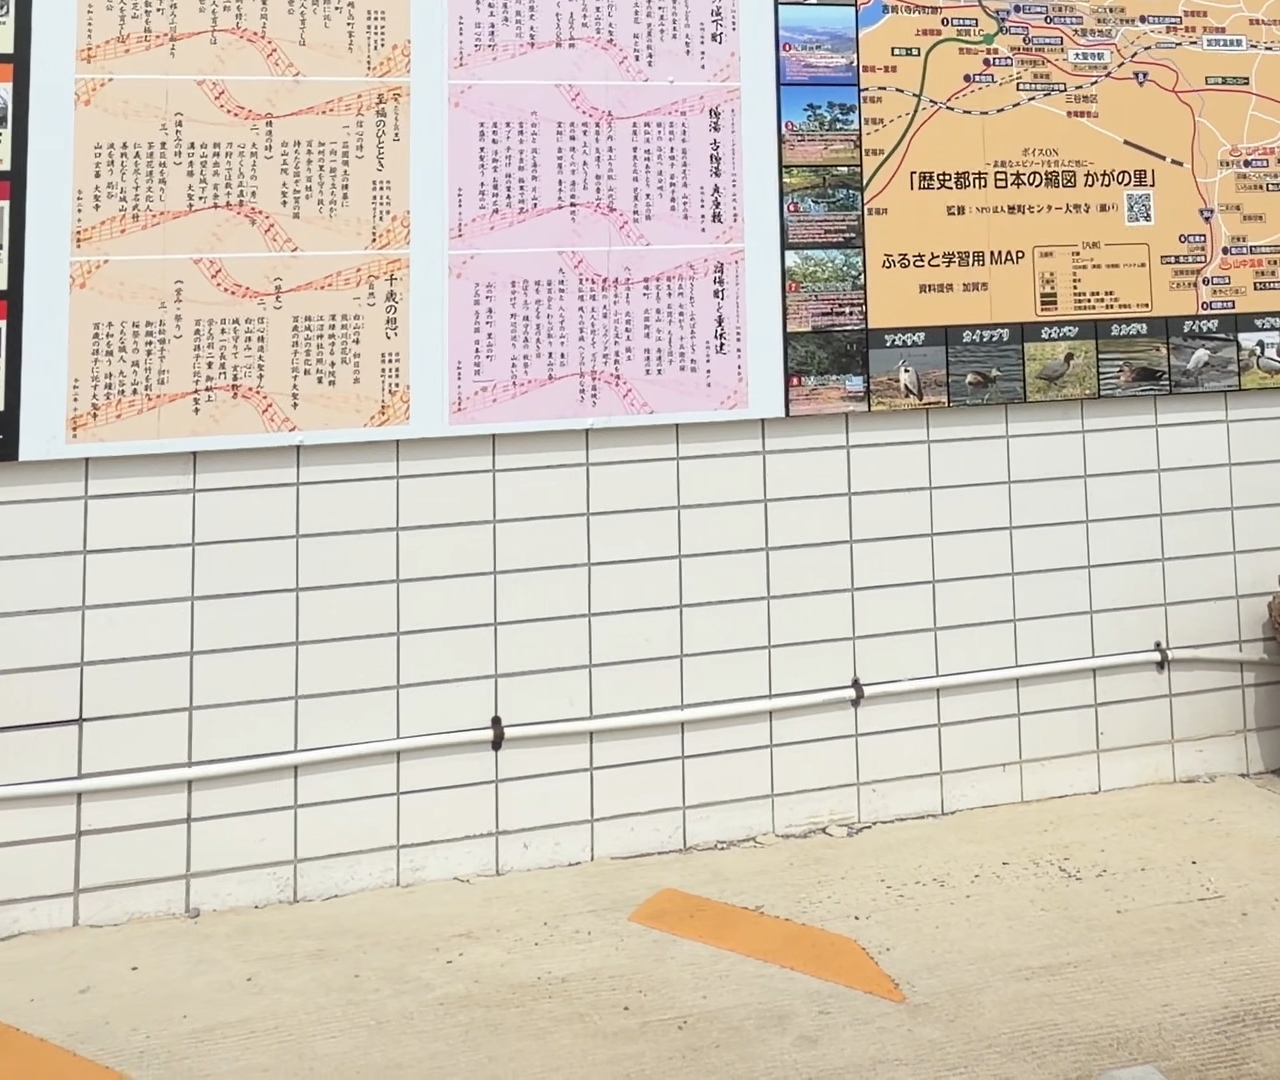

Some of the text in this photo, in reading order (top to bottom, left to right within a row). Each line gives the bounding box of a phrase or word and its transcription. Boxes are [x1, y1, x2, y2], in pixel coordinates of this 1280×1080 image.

[374, 93, 388, 172] 至福のひととき
[1022, 147, 1059, 158] ボイスON
[909, 168, 1157, 191] 「歴史都市 日本の縮図 かがの里」
[881, 250, 1026, 269] ふるさと学習用 MAP
